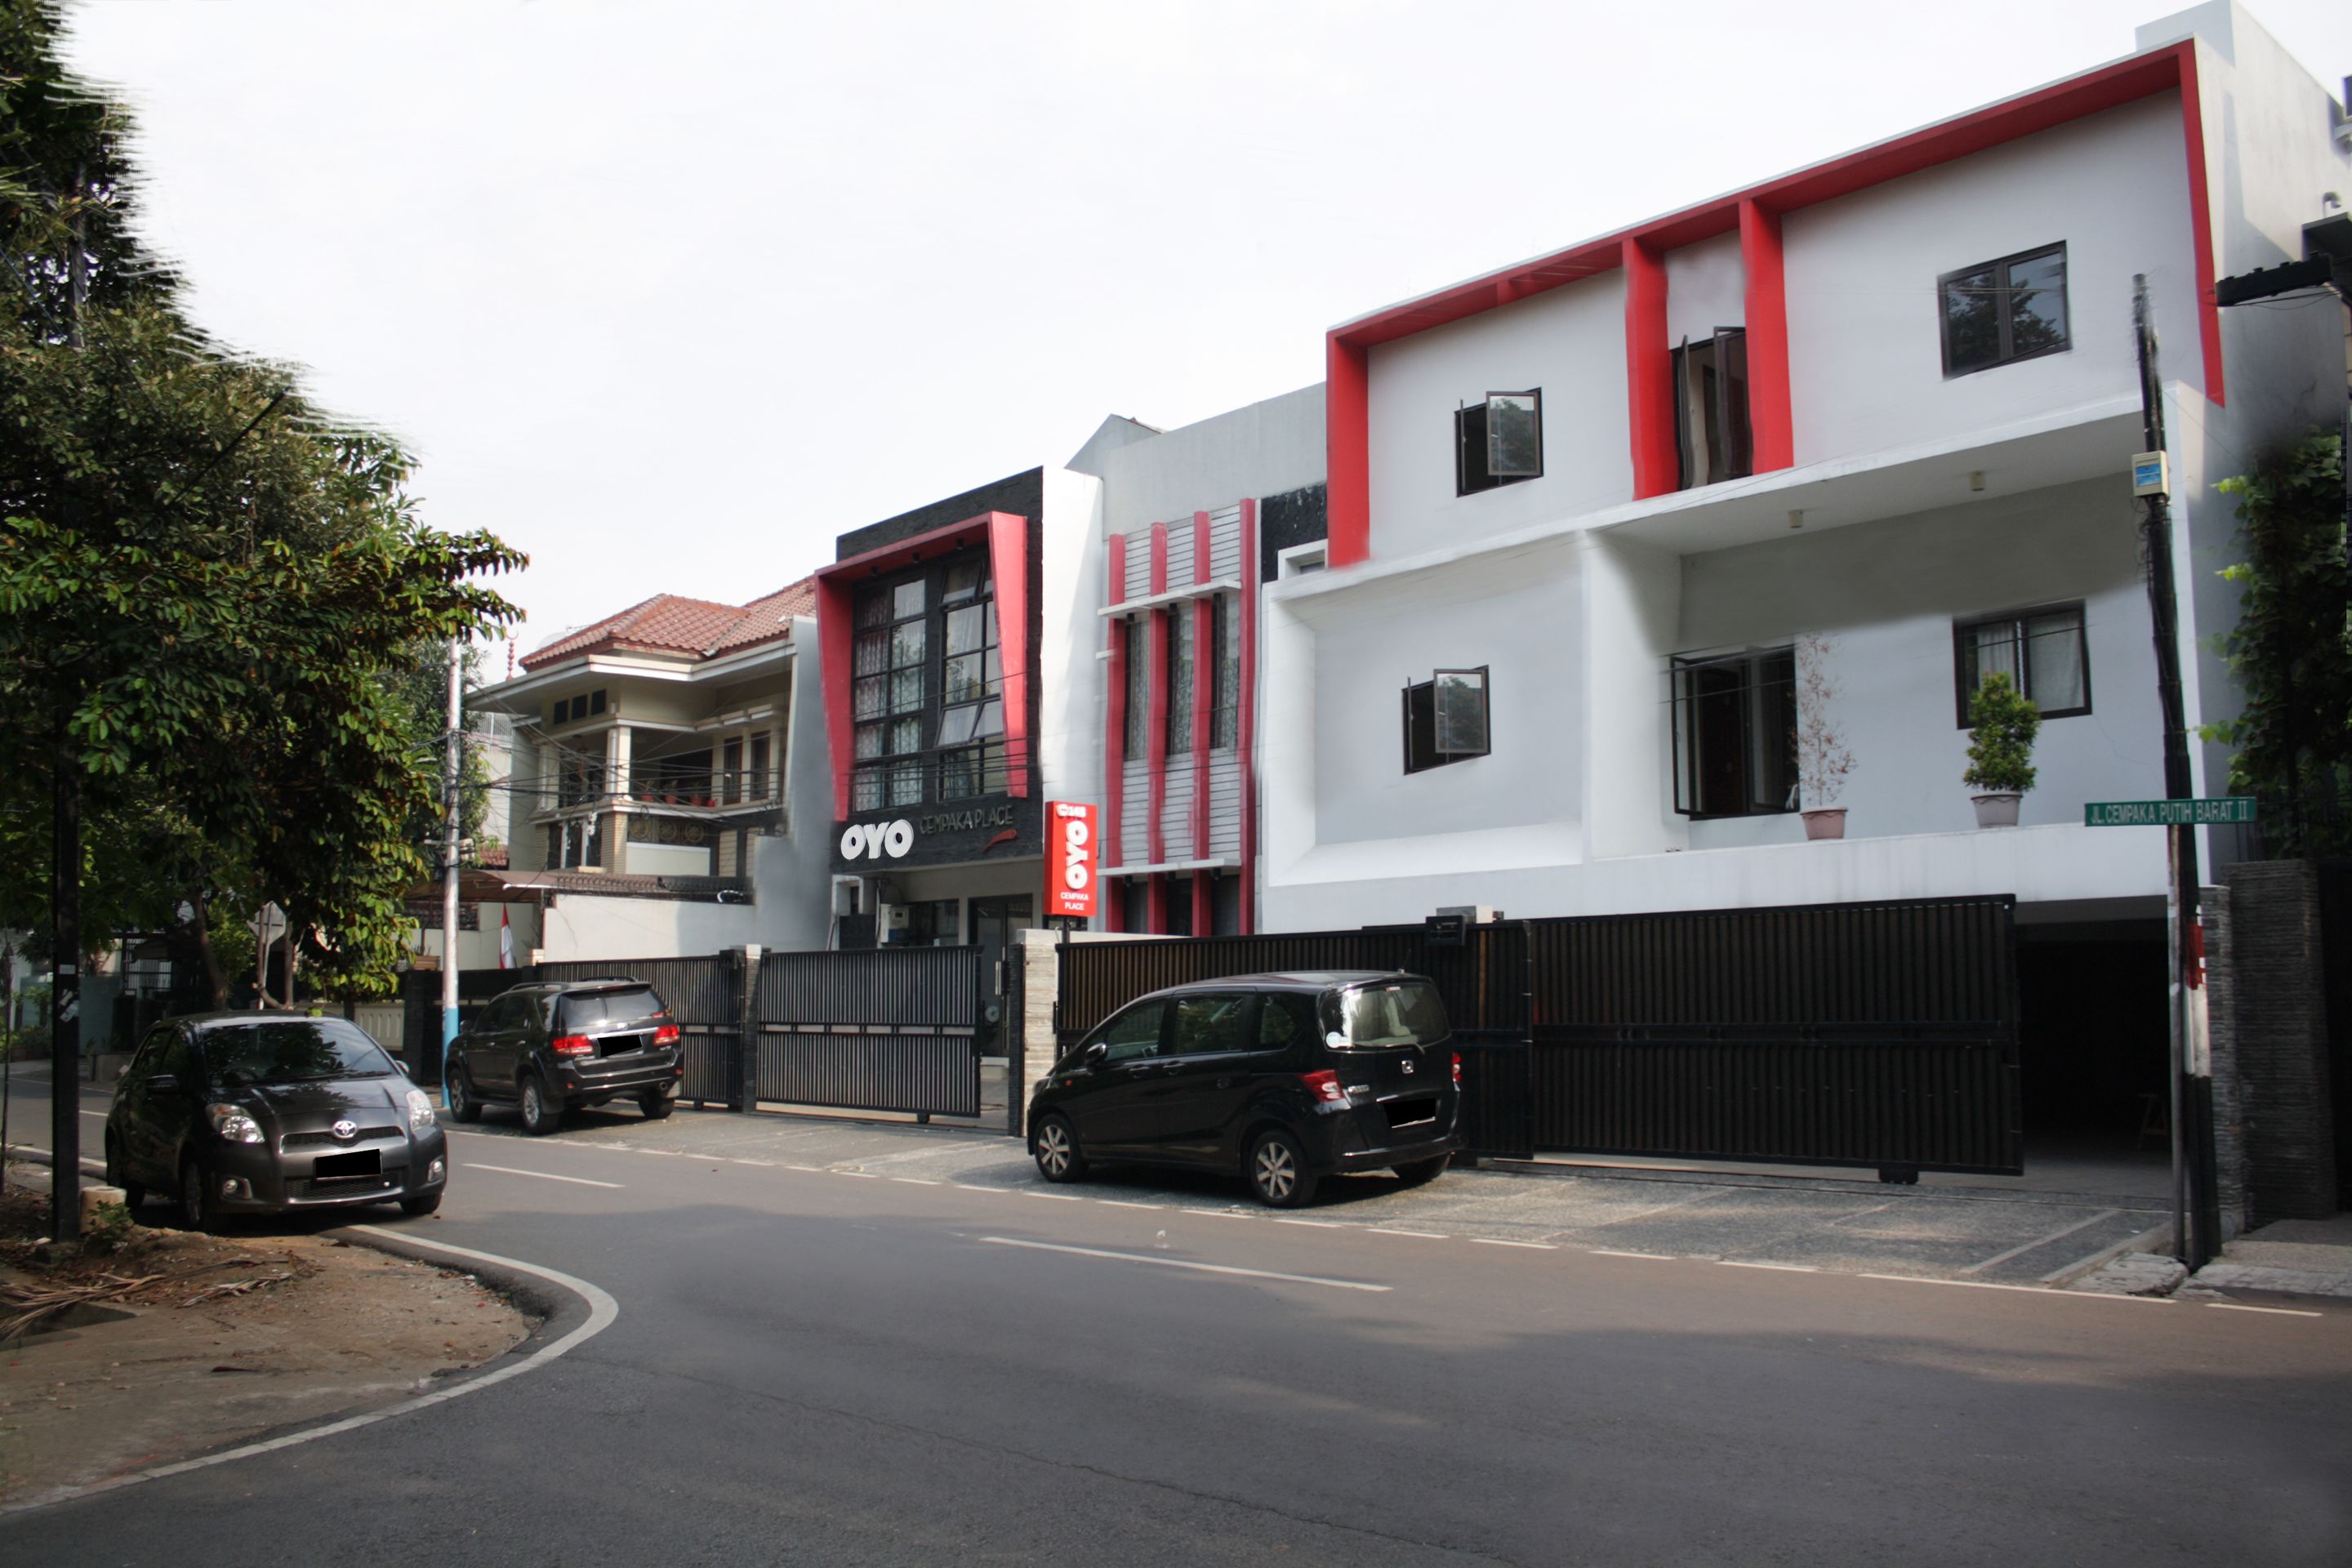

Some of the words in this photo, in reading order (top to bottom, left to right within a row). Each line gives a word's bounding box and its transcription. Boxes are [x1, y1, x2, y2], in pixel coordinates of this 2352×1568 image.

[920, 809, 973, 835] CEMPAKA
[974, 804, 1013, 828] PLACE
[2105, 804, 2156, 824] CEMPAKA
[2159, 802, 2192, 822] PUTIH
[2196, 800, 2234, 822] BARAT
[840, 819, 915, 860] OYO
[1065, 820, 1089, 889] OYO
[1060, 891, 1089, 902] CEMPAKA
[1064, 902, 1085, 911] PLACE
